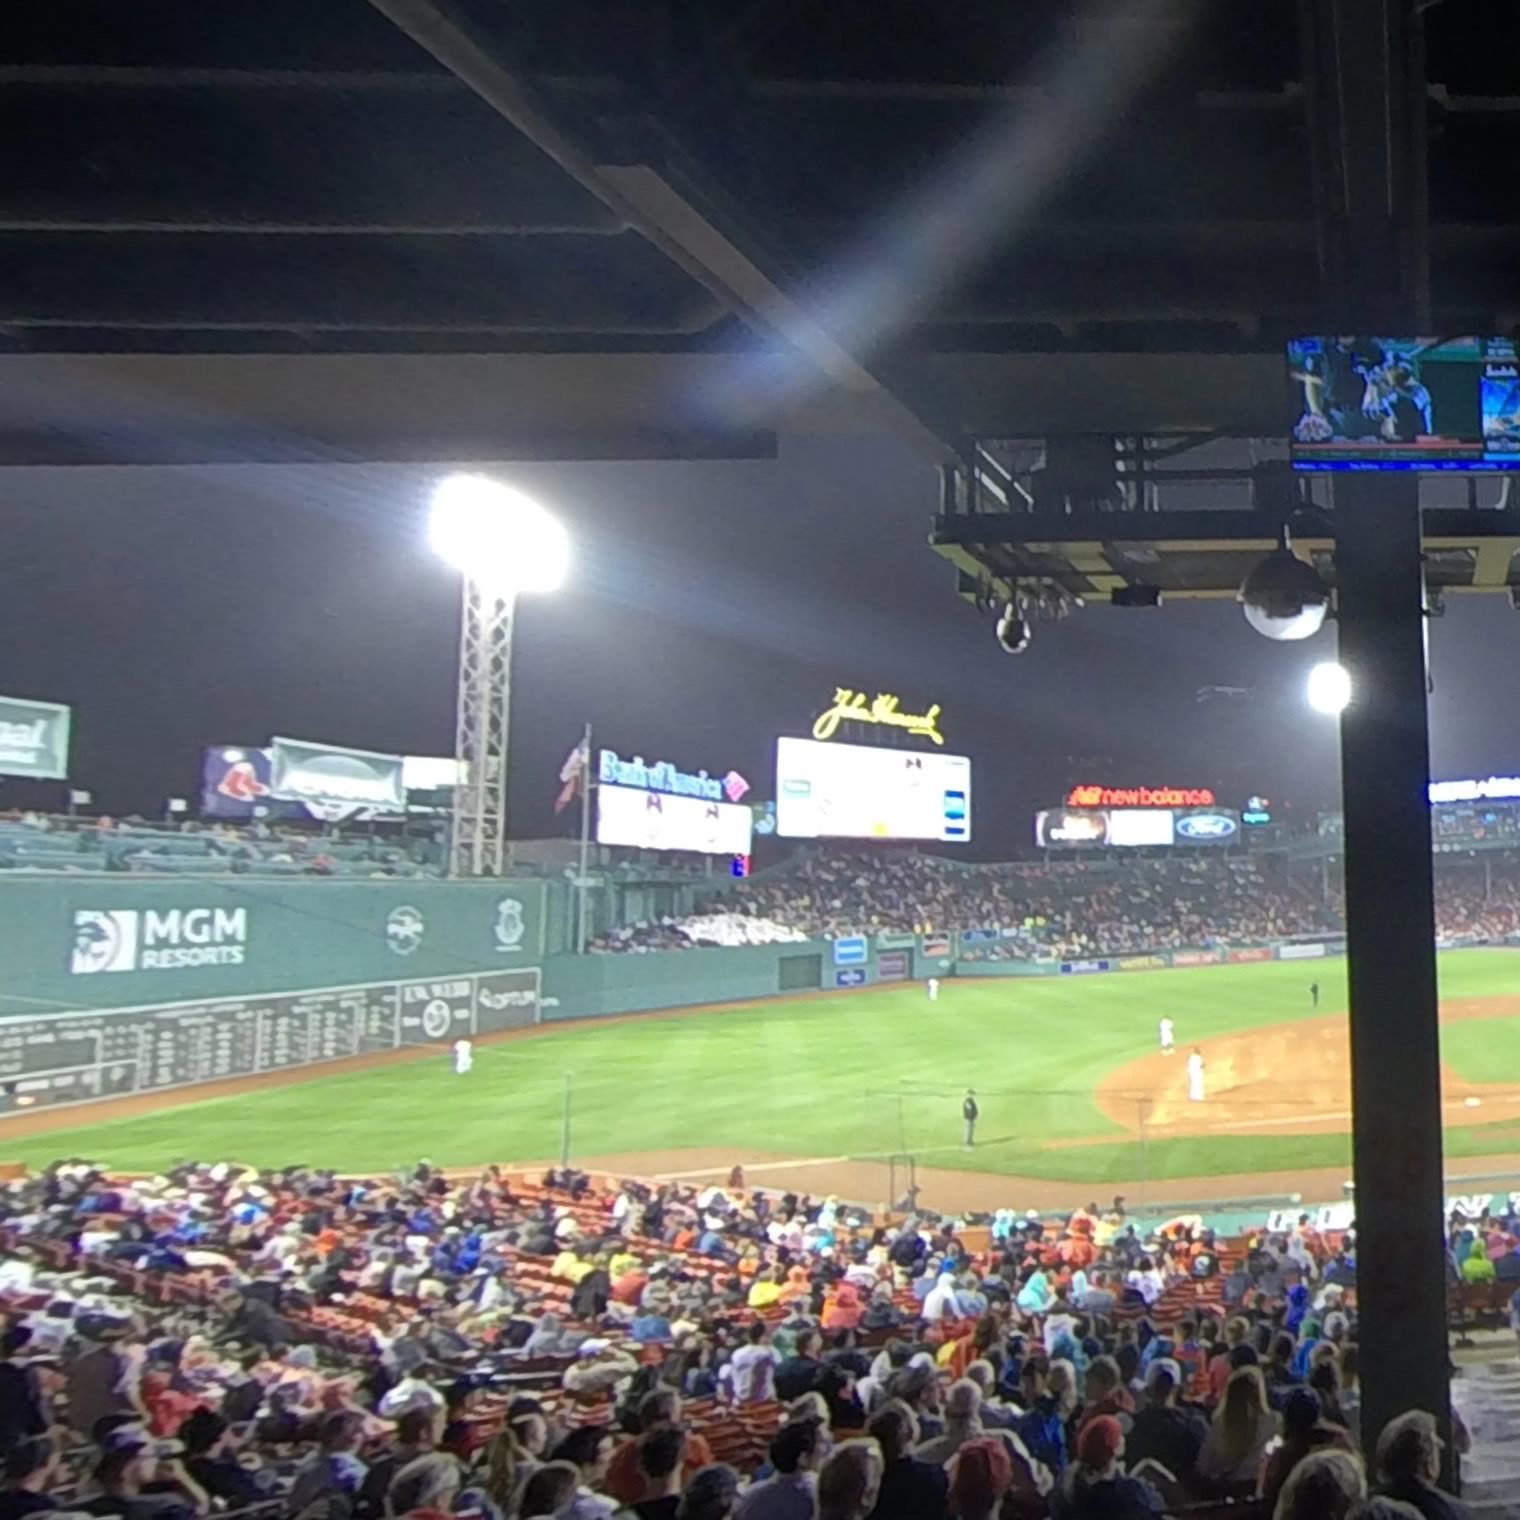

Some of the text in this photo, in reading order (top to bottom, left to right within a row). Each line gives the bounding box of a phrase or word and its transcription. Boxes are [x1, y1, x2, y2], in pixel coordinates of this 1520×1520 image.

[599, 749, 648, 787] Bank
[669, 768, 722, 800] America
[1101, 785, 1214, 806] new balance
[144, 907, 247, 945] MGM
[142, 946, 246, 970] RESORTS
